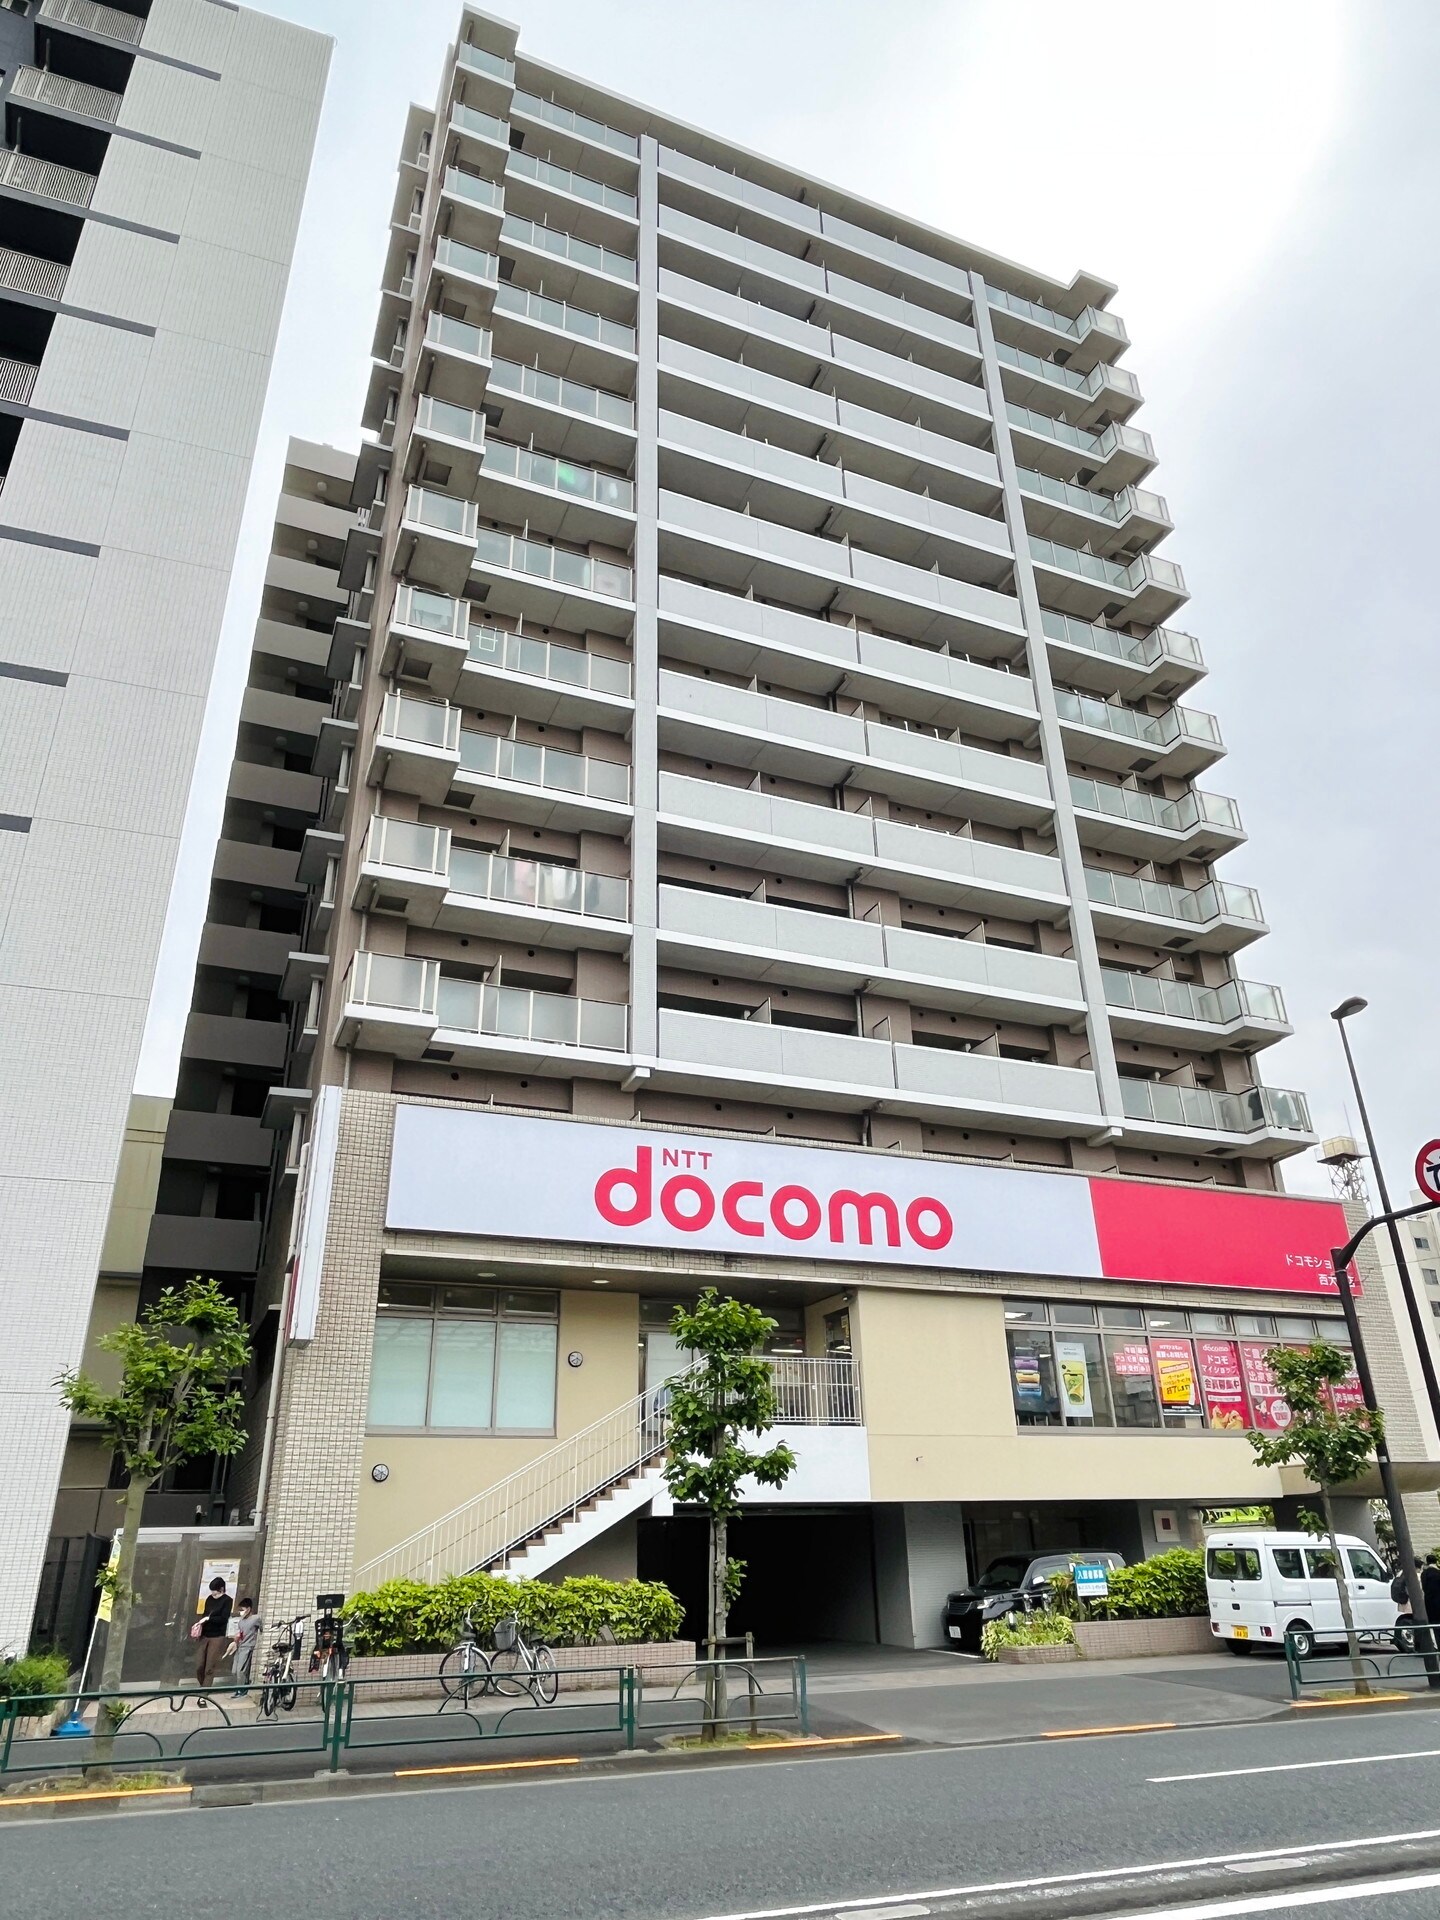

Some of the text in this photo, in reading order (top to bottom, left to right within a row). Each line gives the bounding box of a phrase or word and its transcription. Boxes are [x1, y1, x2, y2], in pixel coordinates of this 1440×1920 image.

[662, 1147, 713, 1170] NTT
[594, 1145, 954, 1251] docomo
[1285, 1253, 1351, 1270] ドコモショ
[1202, 1343, 1229, 1352] docomo
[1207, 1354, 1229, 1365] ドコモ
